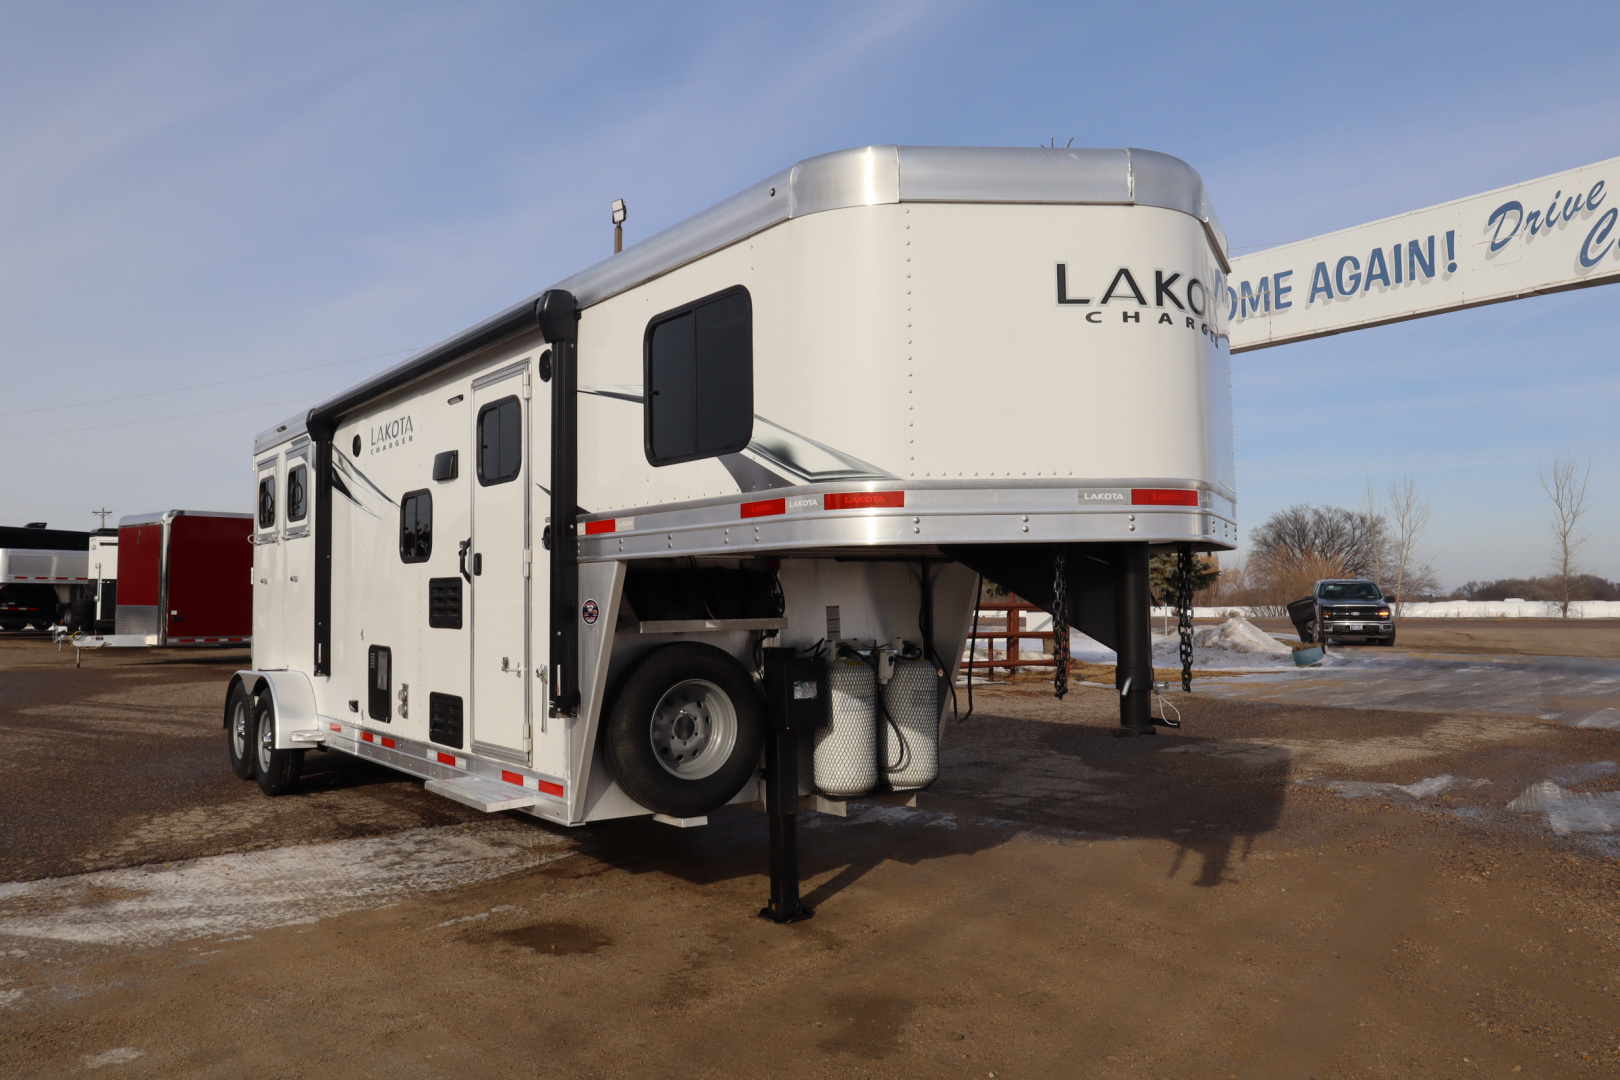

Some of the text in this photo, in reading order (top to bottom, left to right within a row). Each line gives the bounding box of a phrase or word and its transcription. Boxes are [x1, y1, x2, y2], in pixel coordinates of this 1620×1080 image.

[1488, 181, 1607, 252] Drive
[1580, 207, 1620, 268] C
[1309, 230, 1458, 304] AGAIN!
[1056, 262, 1218, 321] LAKO
[370, 415, 414, 446] LAKOTA
[370, 435, 414, 456] CHARGER
[789, 499, 818, 508] LAKOTA
[844, 495, 886, 504] LAKOTA
[1084, 492, 1124, 501] LAKOTA
[1152, 493, 1185, 501] LAKOTA
